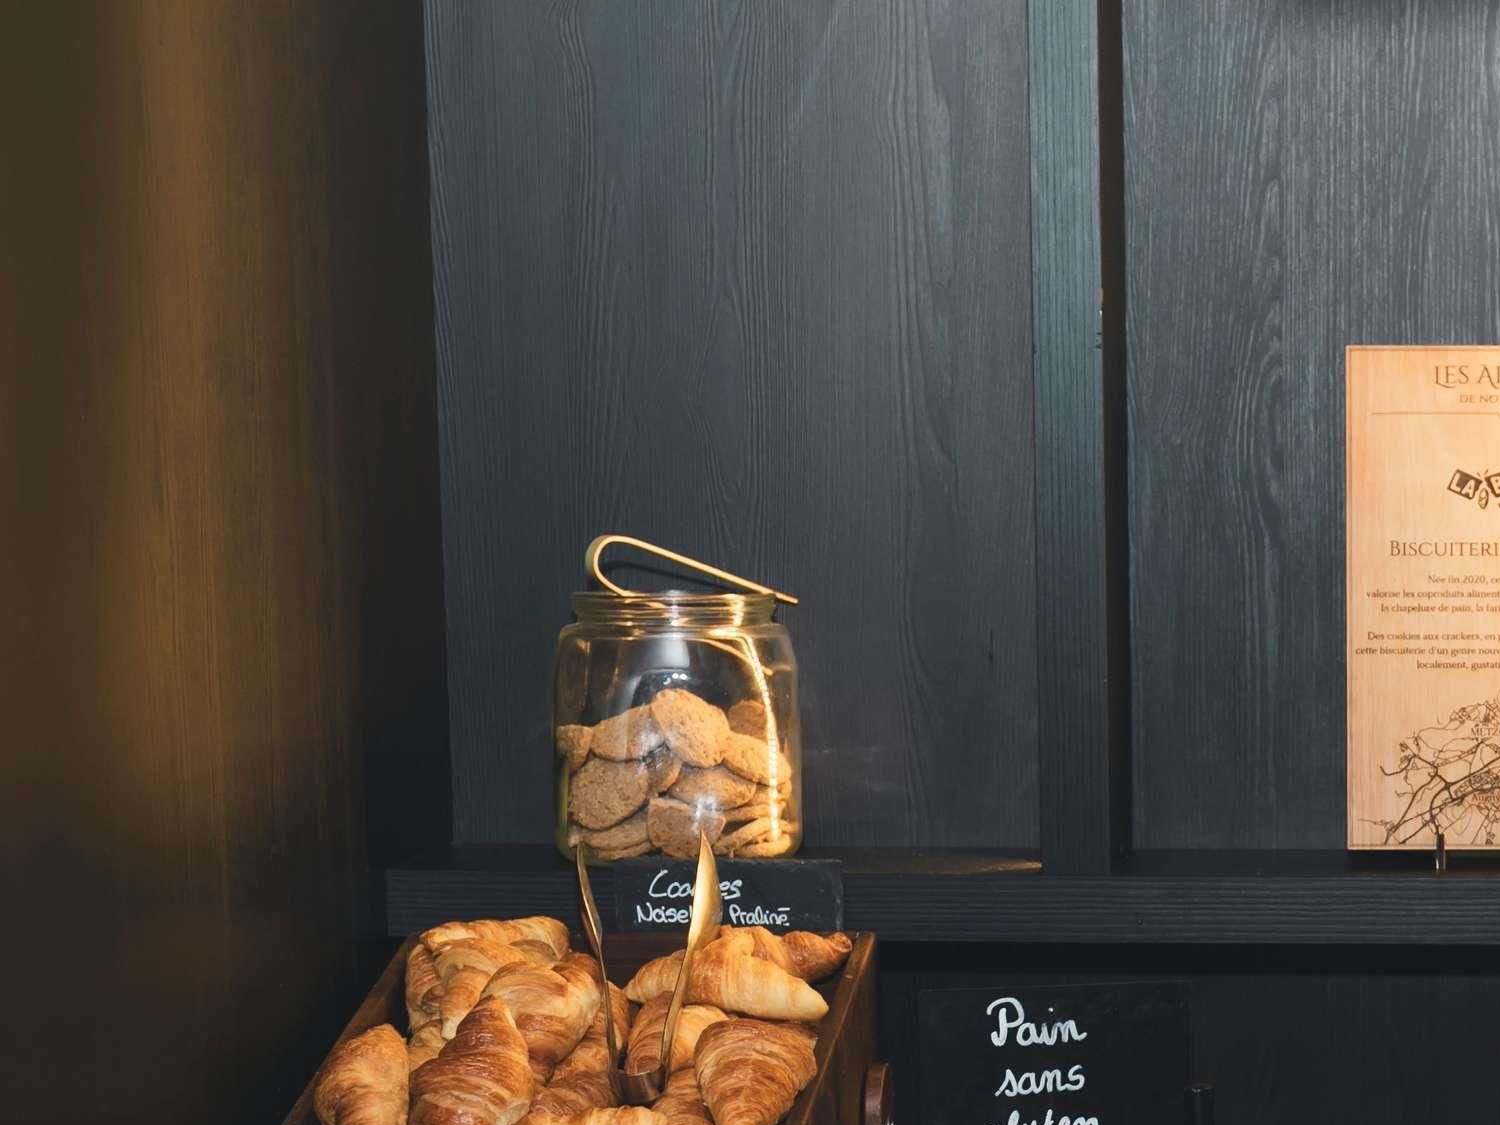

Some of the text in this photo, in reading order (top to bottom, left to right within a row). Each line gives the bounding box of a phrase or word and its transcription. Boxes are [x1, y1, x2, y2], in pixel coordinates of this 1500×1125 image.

[1434, 364, 1470, 389] LES
[1448, 472, 1476, 498] LA
[649, 868, 742, 900] Cooes
[636, 902, 790, 927] Noise Praliné
[986, 996, 1087, 1047] Pain
[994, 1064, 1086, 1097] sans
